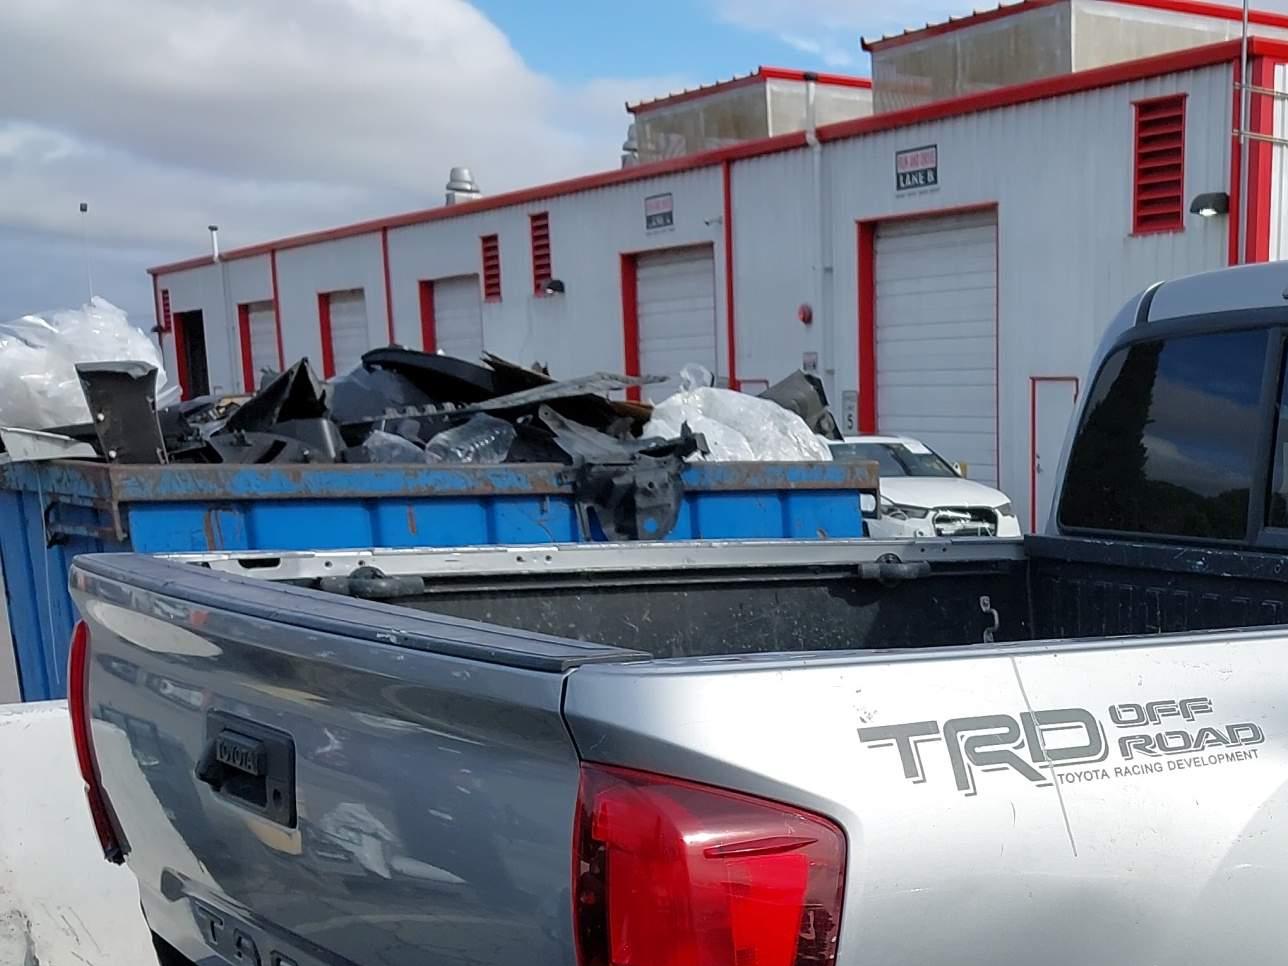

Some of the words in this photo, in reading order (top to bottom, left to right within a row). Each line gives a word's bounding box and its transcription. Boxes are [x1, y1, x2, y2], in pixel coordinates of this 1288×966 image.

[1108, 697, 1213, 727] OFF
[857, 708, 1109, 796] TRD
[1118, 722, 1266, 760] ROAD
[1057, 768, 1110, 785] TOYOTA
[1114, 761, 1164, 778] RACING
[1167, 749, 1260, 771] DEVELOPMENT
